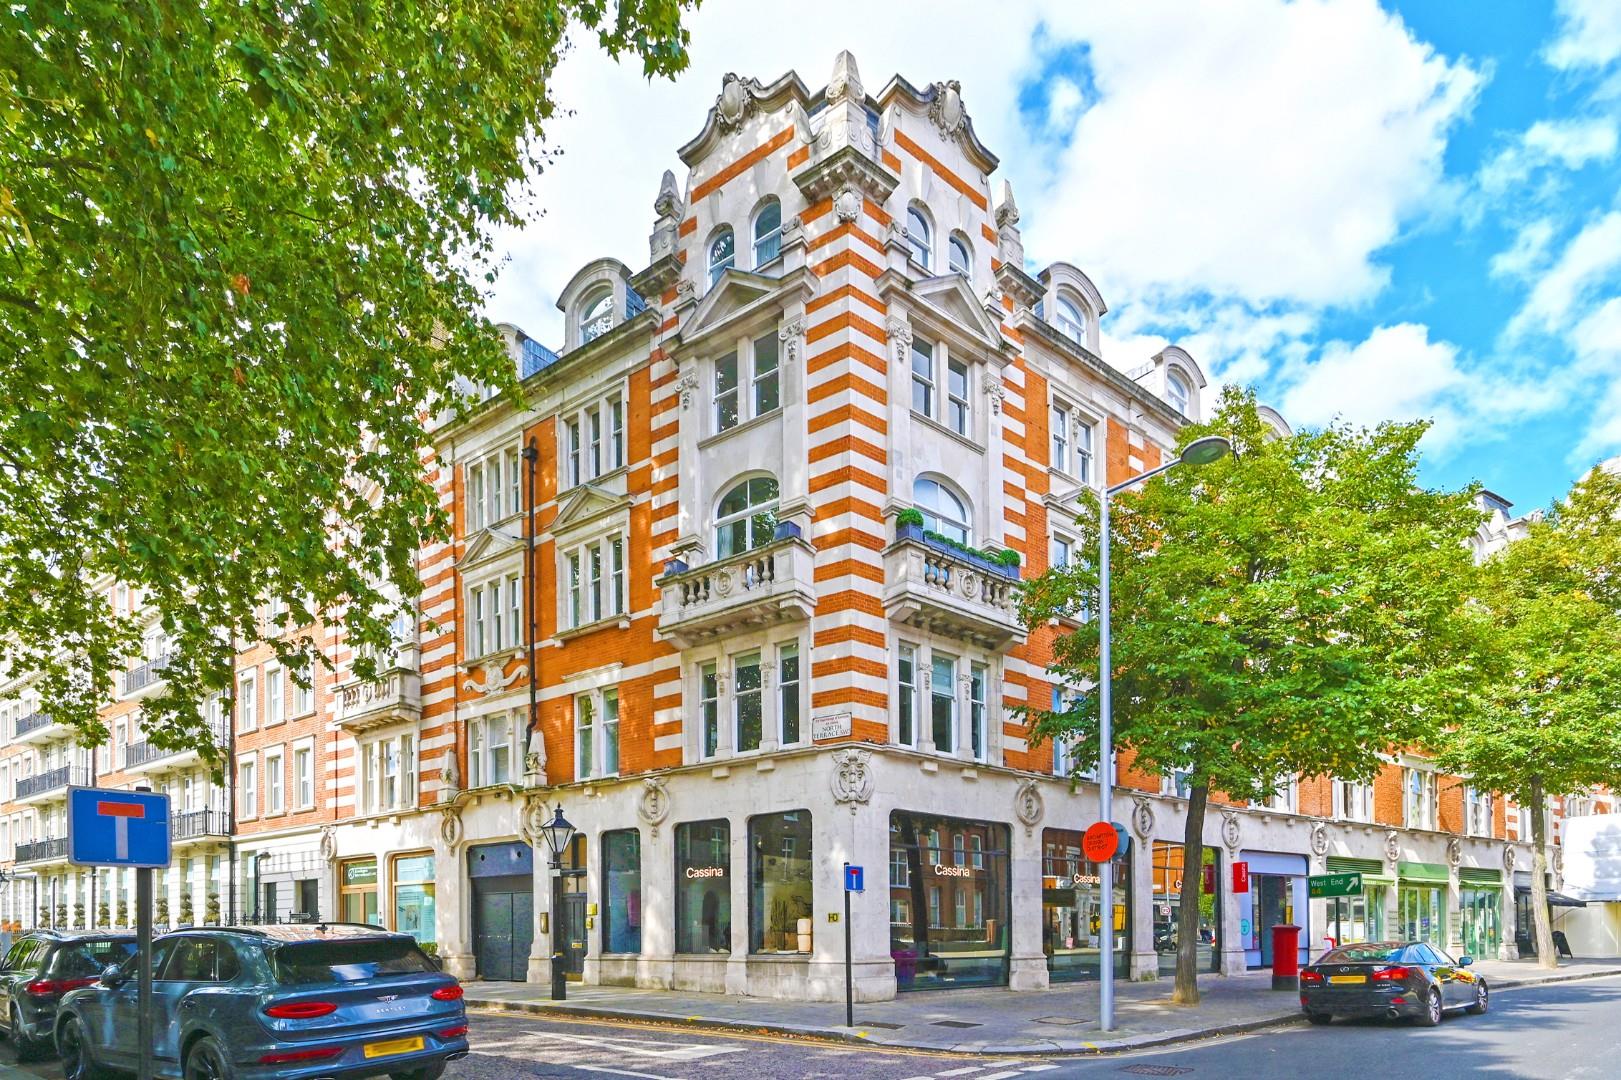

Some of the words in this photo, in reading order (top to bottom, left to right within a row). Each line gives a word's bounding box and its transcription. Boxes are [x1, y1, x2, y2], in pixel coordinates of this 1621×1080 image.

[813, 730, 840, 739] TERRACE
[686, 866, 723, 878] Cassina
[934, 864, 970, 877] Cassina
[1073, 873, 1101, 884] Cassina
[1310, 879, 1326, 887] West
